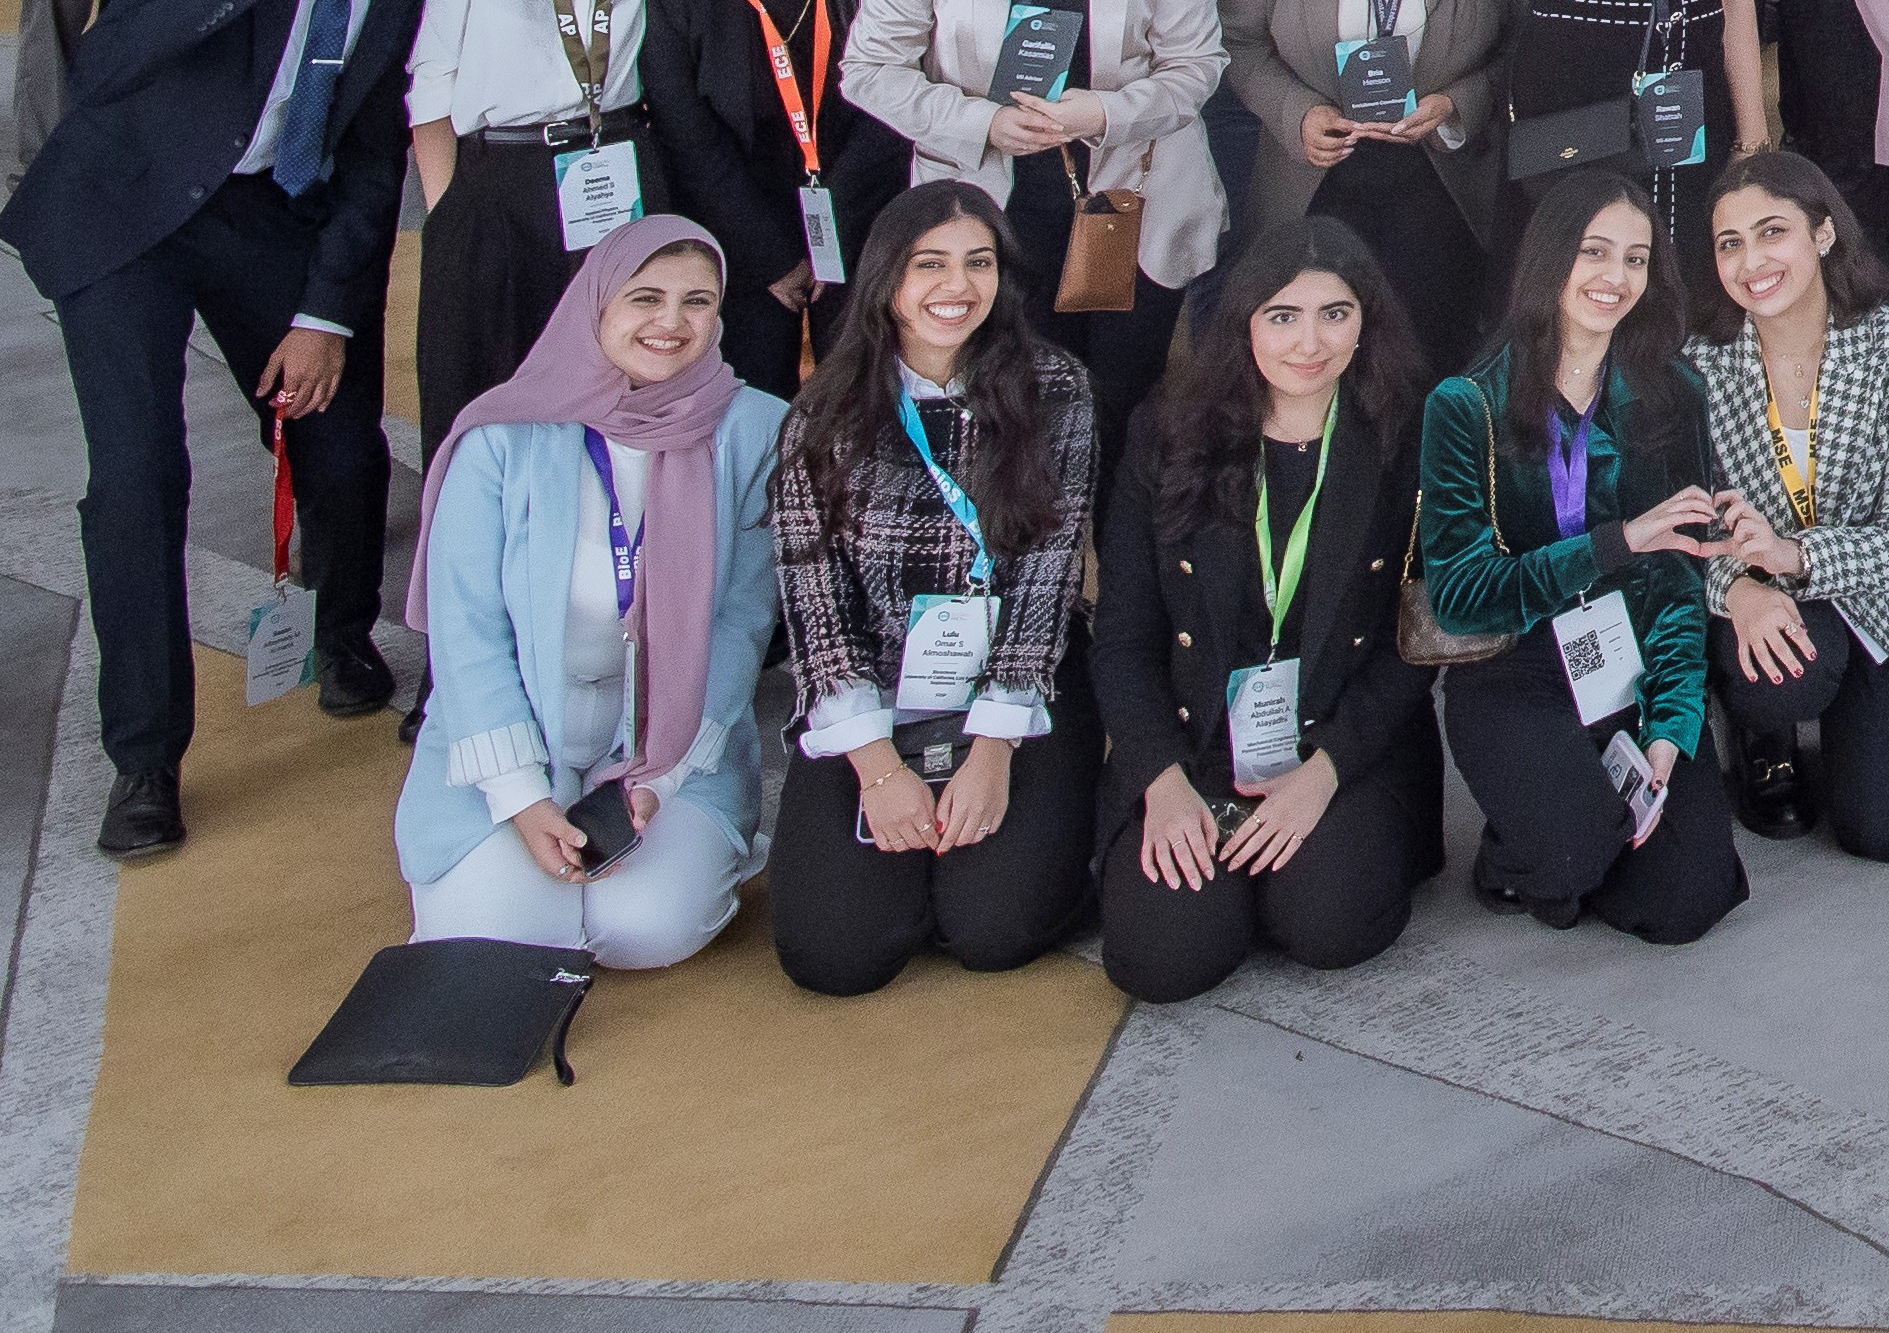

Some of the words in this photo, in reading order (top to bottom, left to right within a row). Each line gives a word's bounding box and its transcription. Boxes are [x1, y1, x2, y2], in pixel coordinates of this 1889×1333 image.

[558, 14, 577, 36] AP
[594, 10, 610, 34] AP
[771, 44, 793, 80] ECE
[1362, 78, 1391, 86] Henson
[790, 110, 811, 143] ECE
[583, 183, 609, 193] Ahmed
[585, 176, 610, 185] Deema
[586, 191, 614, 201] Alyahya
[1770, 428, 1793, 469] MSE
[616, 545, 632, 580] BioE
[935, 639, 957, 647] Omar
[1251, 708, 1283, 719] Abdullah
